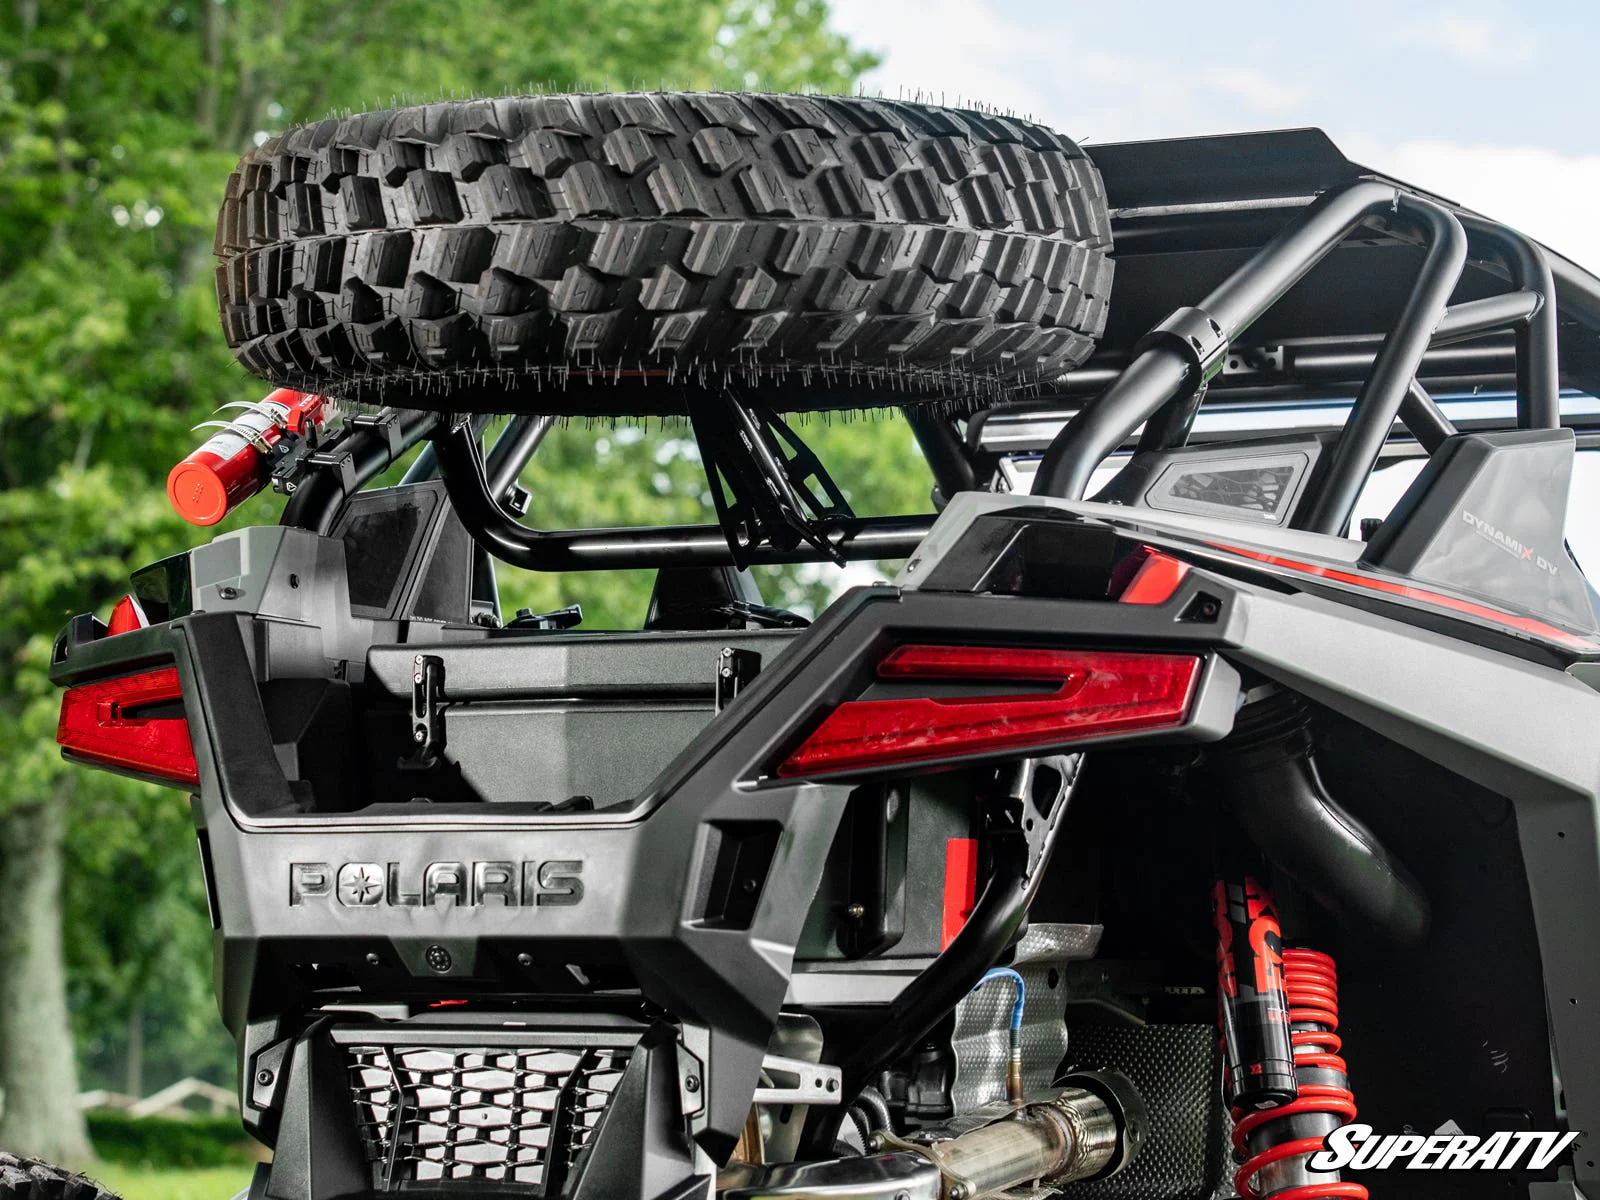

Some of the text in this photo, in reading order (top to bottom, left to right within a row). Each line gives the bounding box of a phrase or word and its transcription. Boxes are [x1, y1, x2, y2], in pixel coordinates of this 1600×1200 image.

[1462, 510, 1534, 561] DYNAMIX
[1536, 555, 1558, 576] DV
[288, 860, 585, 907] POLARIS
